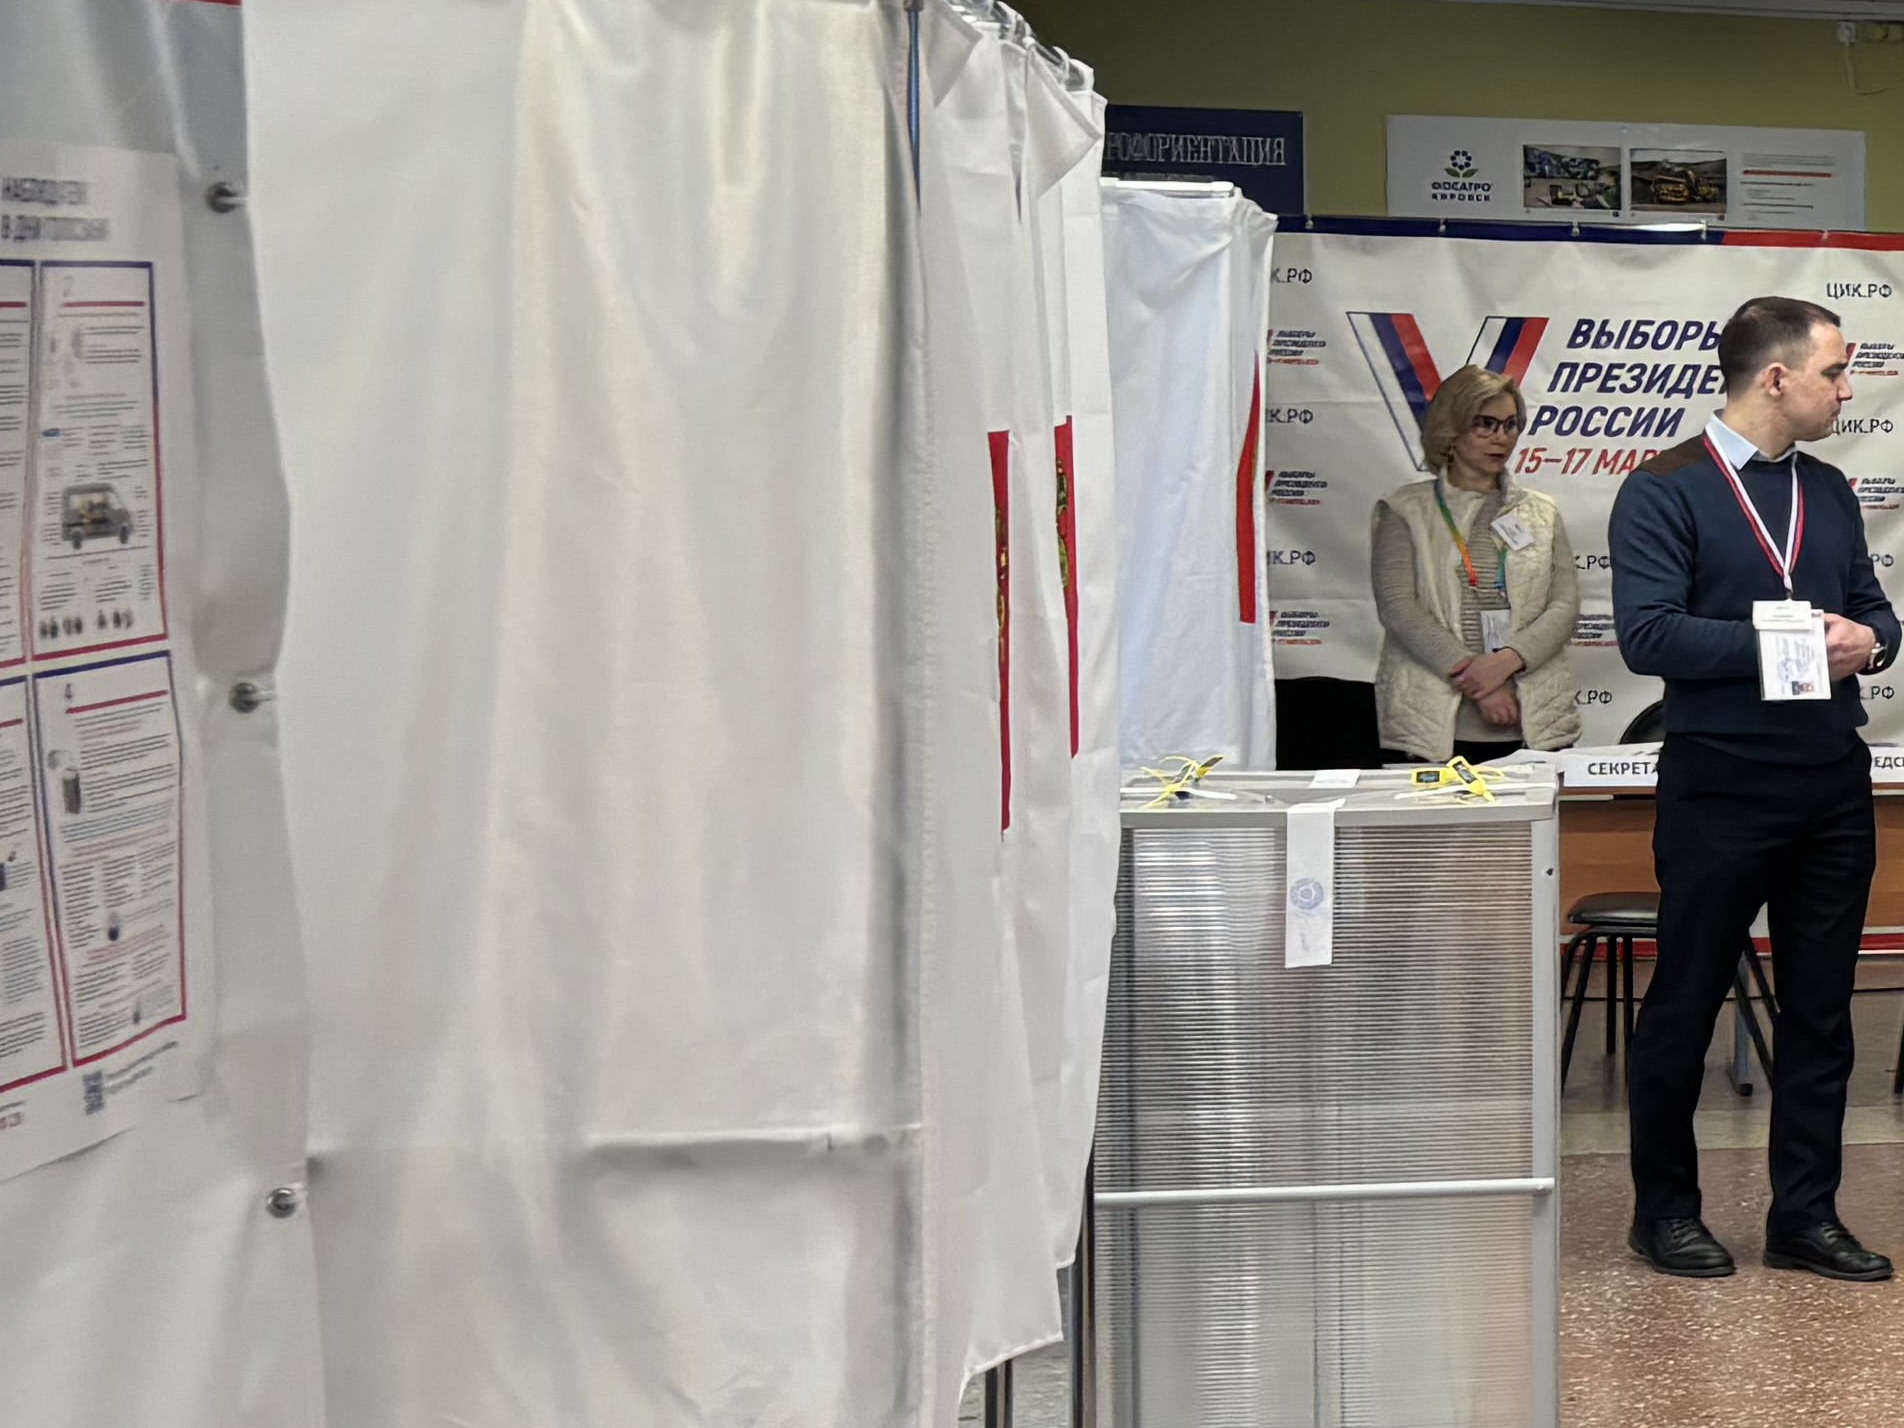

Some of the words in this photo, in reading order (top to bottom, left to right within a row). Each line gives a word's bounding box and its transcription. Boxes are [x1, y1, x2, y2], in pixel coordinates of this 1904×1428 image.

[1105, 132, 1286, 165] РОФОРИЕНТАЦИЯ
[1826, 283, 1892, 299] ЦИК.РФ
[1547, 362, 1726, 399] ПРЕЗИДЕ
[1527, 405, 1686, 438] РОССИИ
